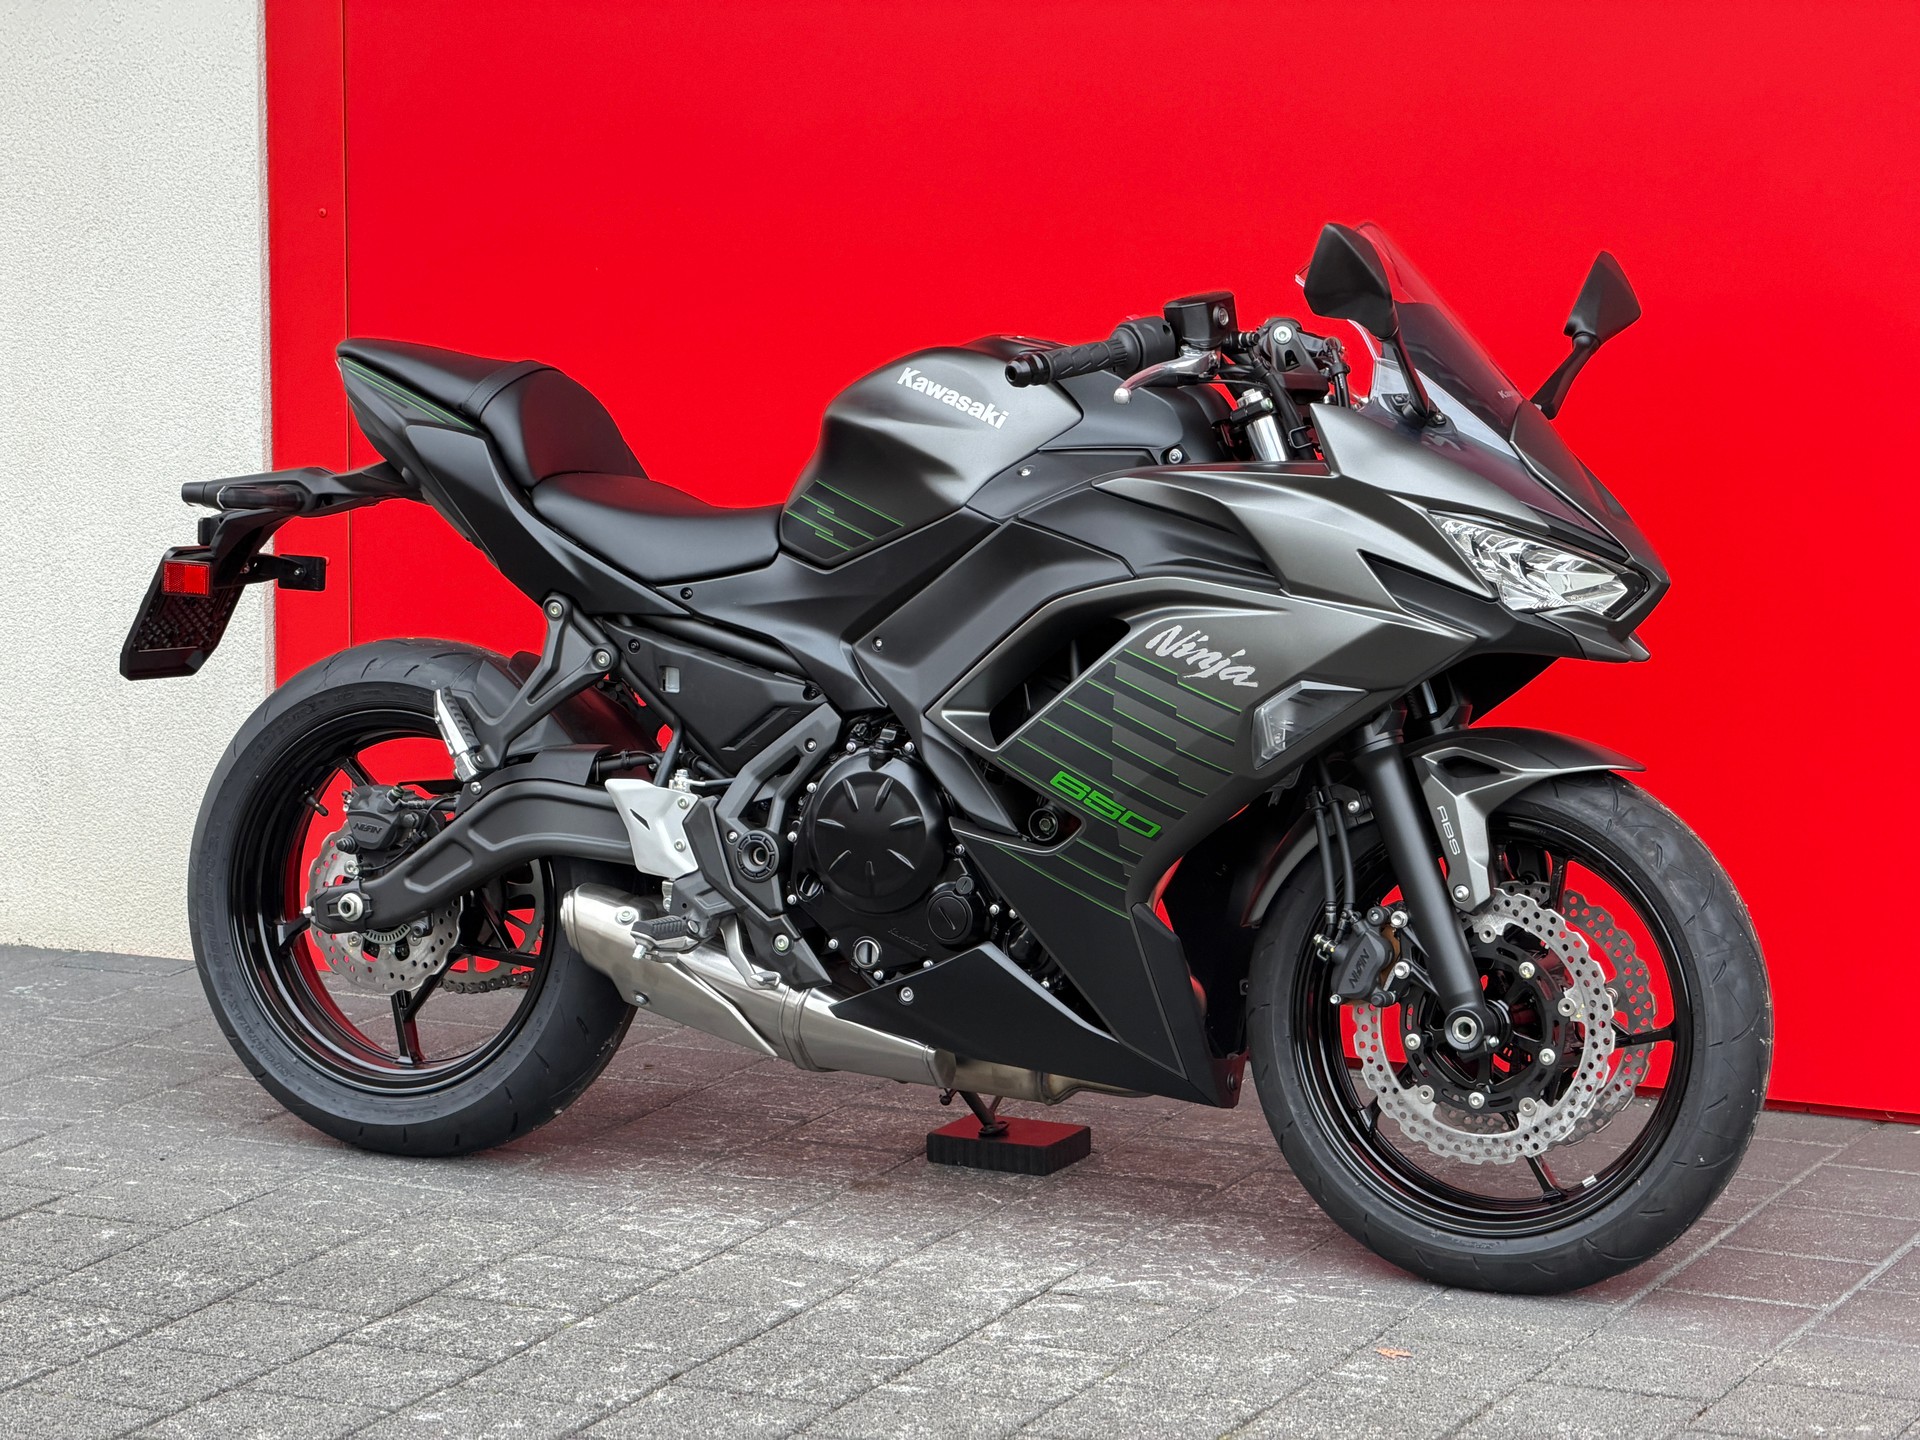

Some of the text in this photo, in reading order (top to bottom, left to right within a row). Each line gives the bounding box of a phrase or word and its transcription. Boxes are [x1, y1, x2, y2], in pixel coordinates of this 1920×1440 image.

[897, 367, 1009, 430] Kawasaki
[1145, 625, 1258, 687] Ninja
[1050, 770, 1162, 838] 650
[1437, 805, 1460, 856] ABS
